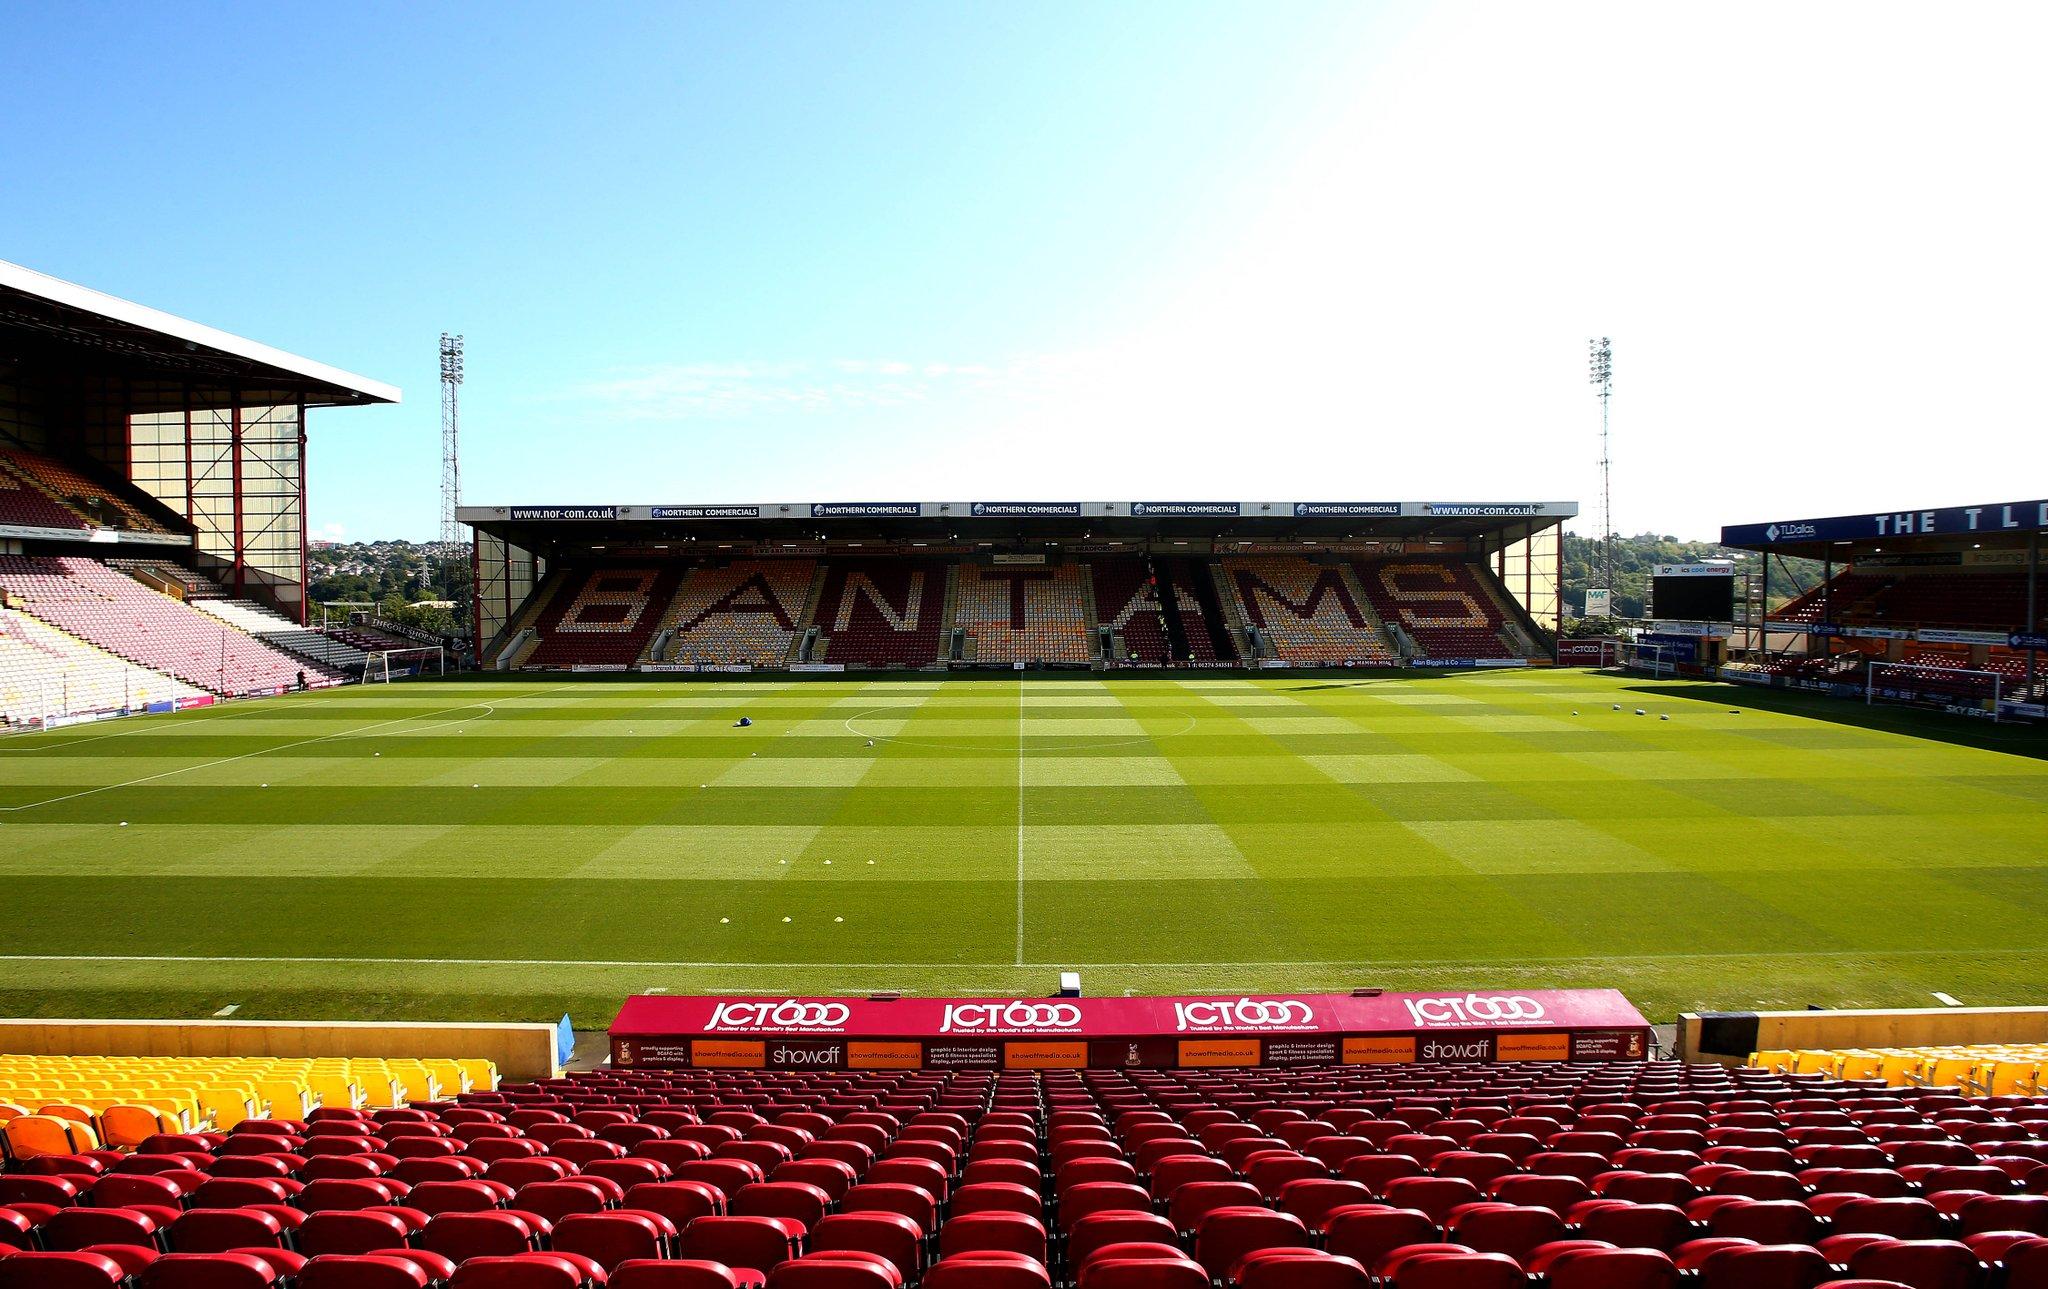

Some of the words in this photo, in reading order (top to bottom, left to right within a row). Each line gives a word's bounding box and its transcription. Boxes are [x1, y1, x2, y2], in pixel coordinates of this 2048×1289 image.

[513, 507, 614, 519] www.nor-com.co.uk
[661, 508, 703, 517] NORTHERN
[705, 508, 757, 517] COMMERCIALS
[825, 506, 866, 515] NORTHERN
[866, 506, 917, 515] COMMERCIALS
[985, 505, 1026, 515] NORTHERN
[1027, 505, 1077, 515] COMMERCIALS
[1145, 505, 1186, 514] NORTHERN
[1187, 505, 1237, 514] COMMERCIALS
[1308, 505, 1348, 514] NORTHERN
[1348, 505, 1398, 514] COMMERCIALS
[1431, 504, 1537, 515] www.nor-com.co.uk
[1875, 511, 1935, 535] THE
[703, 1000, 850, 1031] JCT600
[939, 1000, 1082, 1032] JCT600
[1174, 998, 1314, 1031] JCT600
[1403, 994, 1545, 1027] JCT600
[1345, 1047, 1413, 1055] showoffmedia.co.uk
[1423, 1039, 1489, 1058] showoff
[773, 1045, 840, 1064] showoff
[1011, 1052, 1081, 1060] showoffmedia.co.uk
